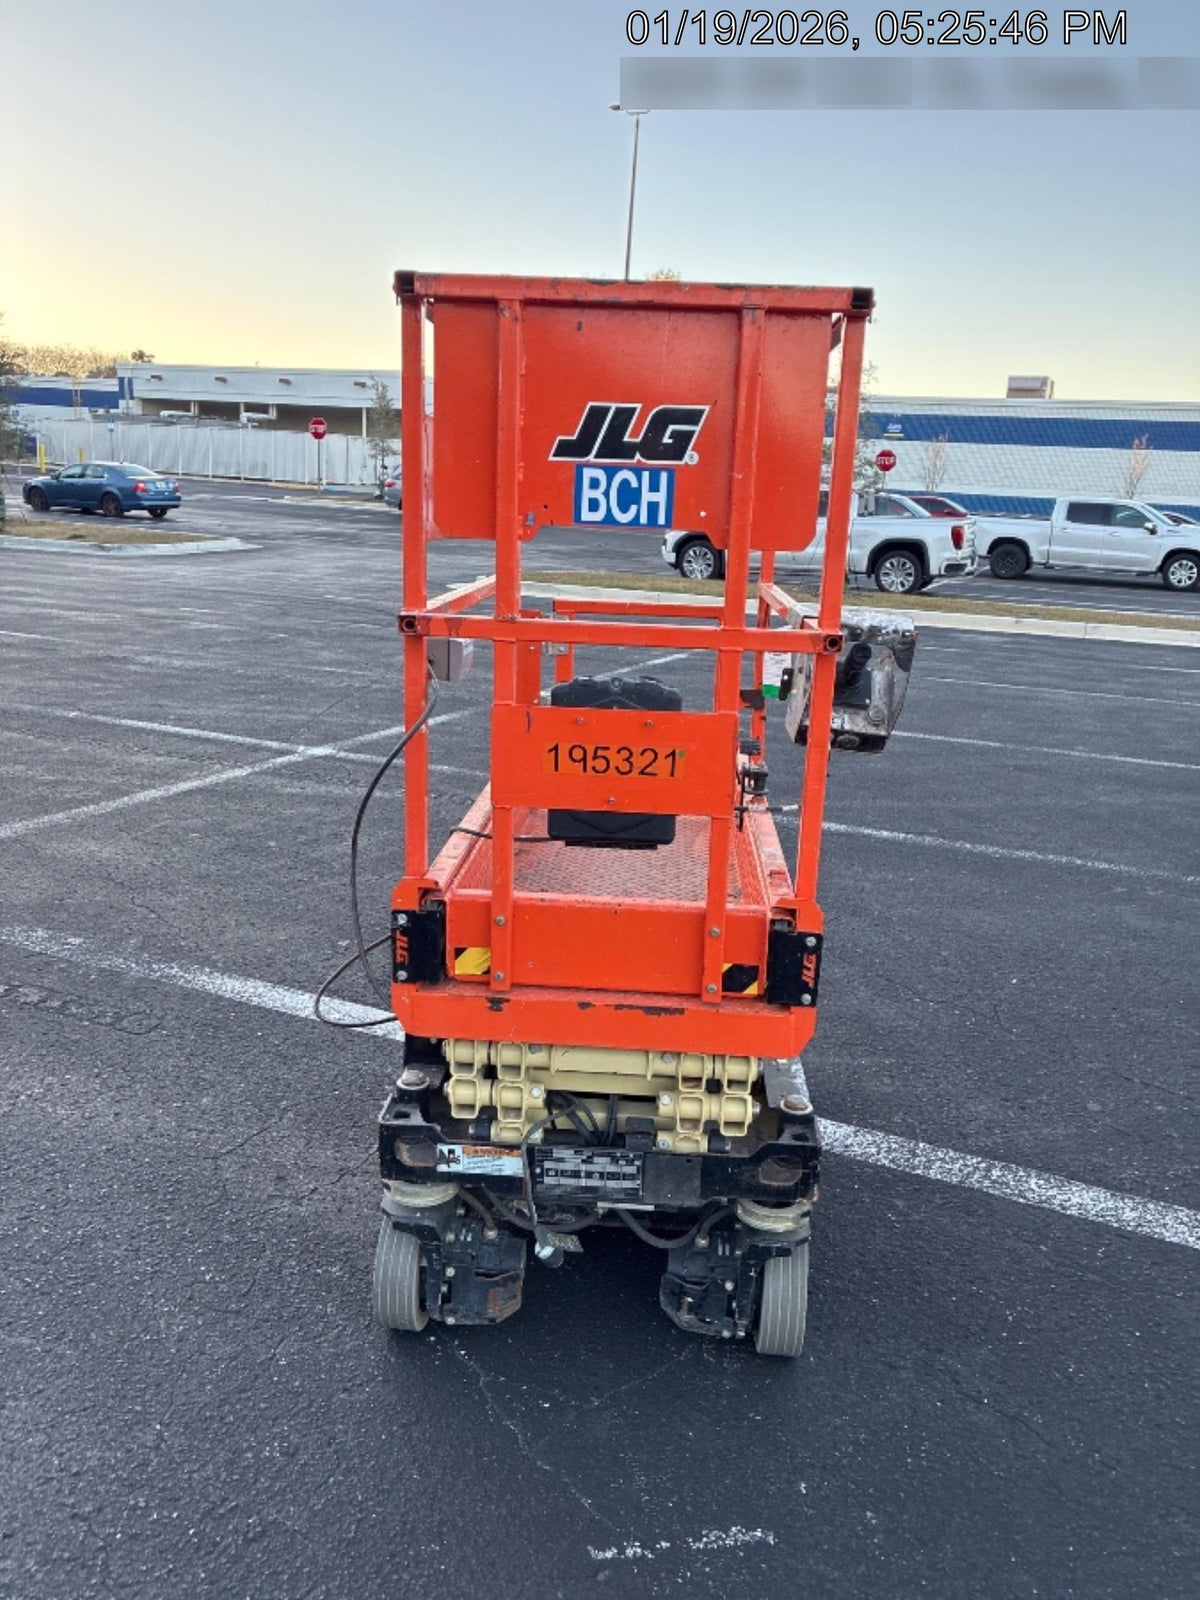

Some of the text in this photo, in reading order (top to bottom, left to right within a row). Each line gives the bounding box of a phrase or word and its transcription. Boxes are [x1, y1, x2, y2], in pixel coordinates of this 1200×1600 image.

[548, 401, 711, 465] JLG
[875, 456, 895, 465] STOP
[581, 467, 668, 525] BCH
[547, 743, 677, 777] 195321
[396, 929, 409, 965] JLG
[802, 952, 817, 989] JLG
